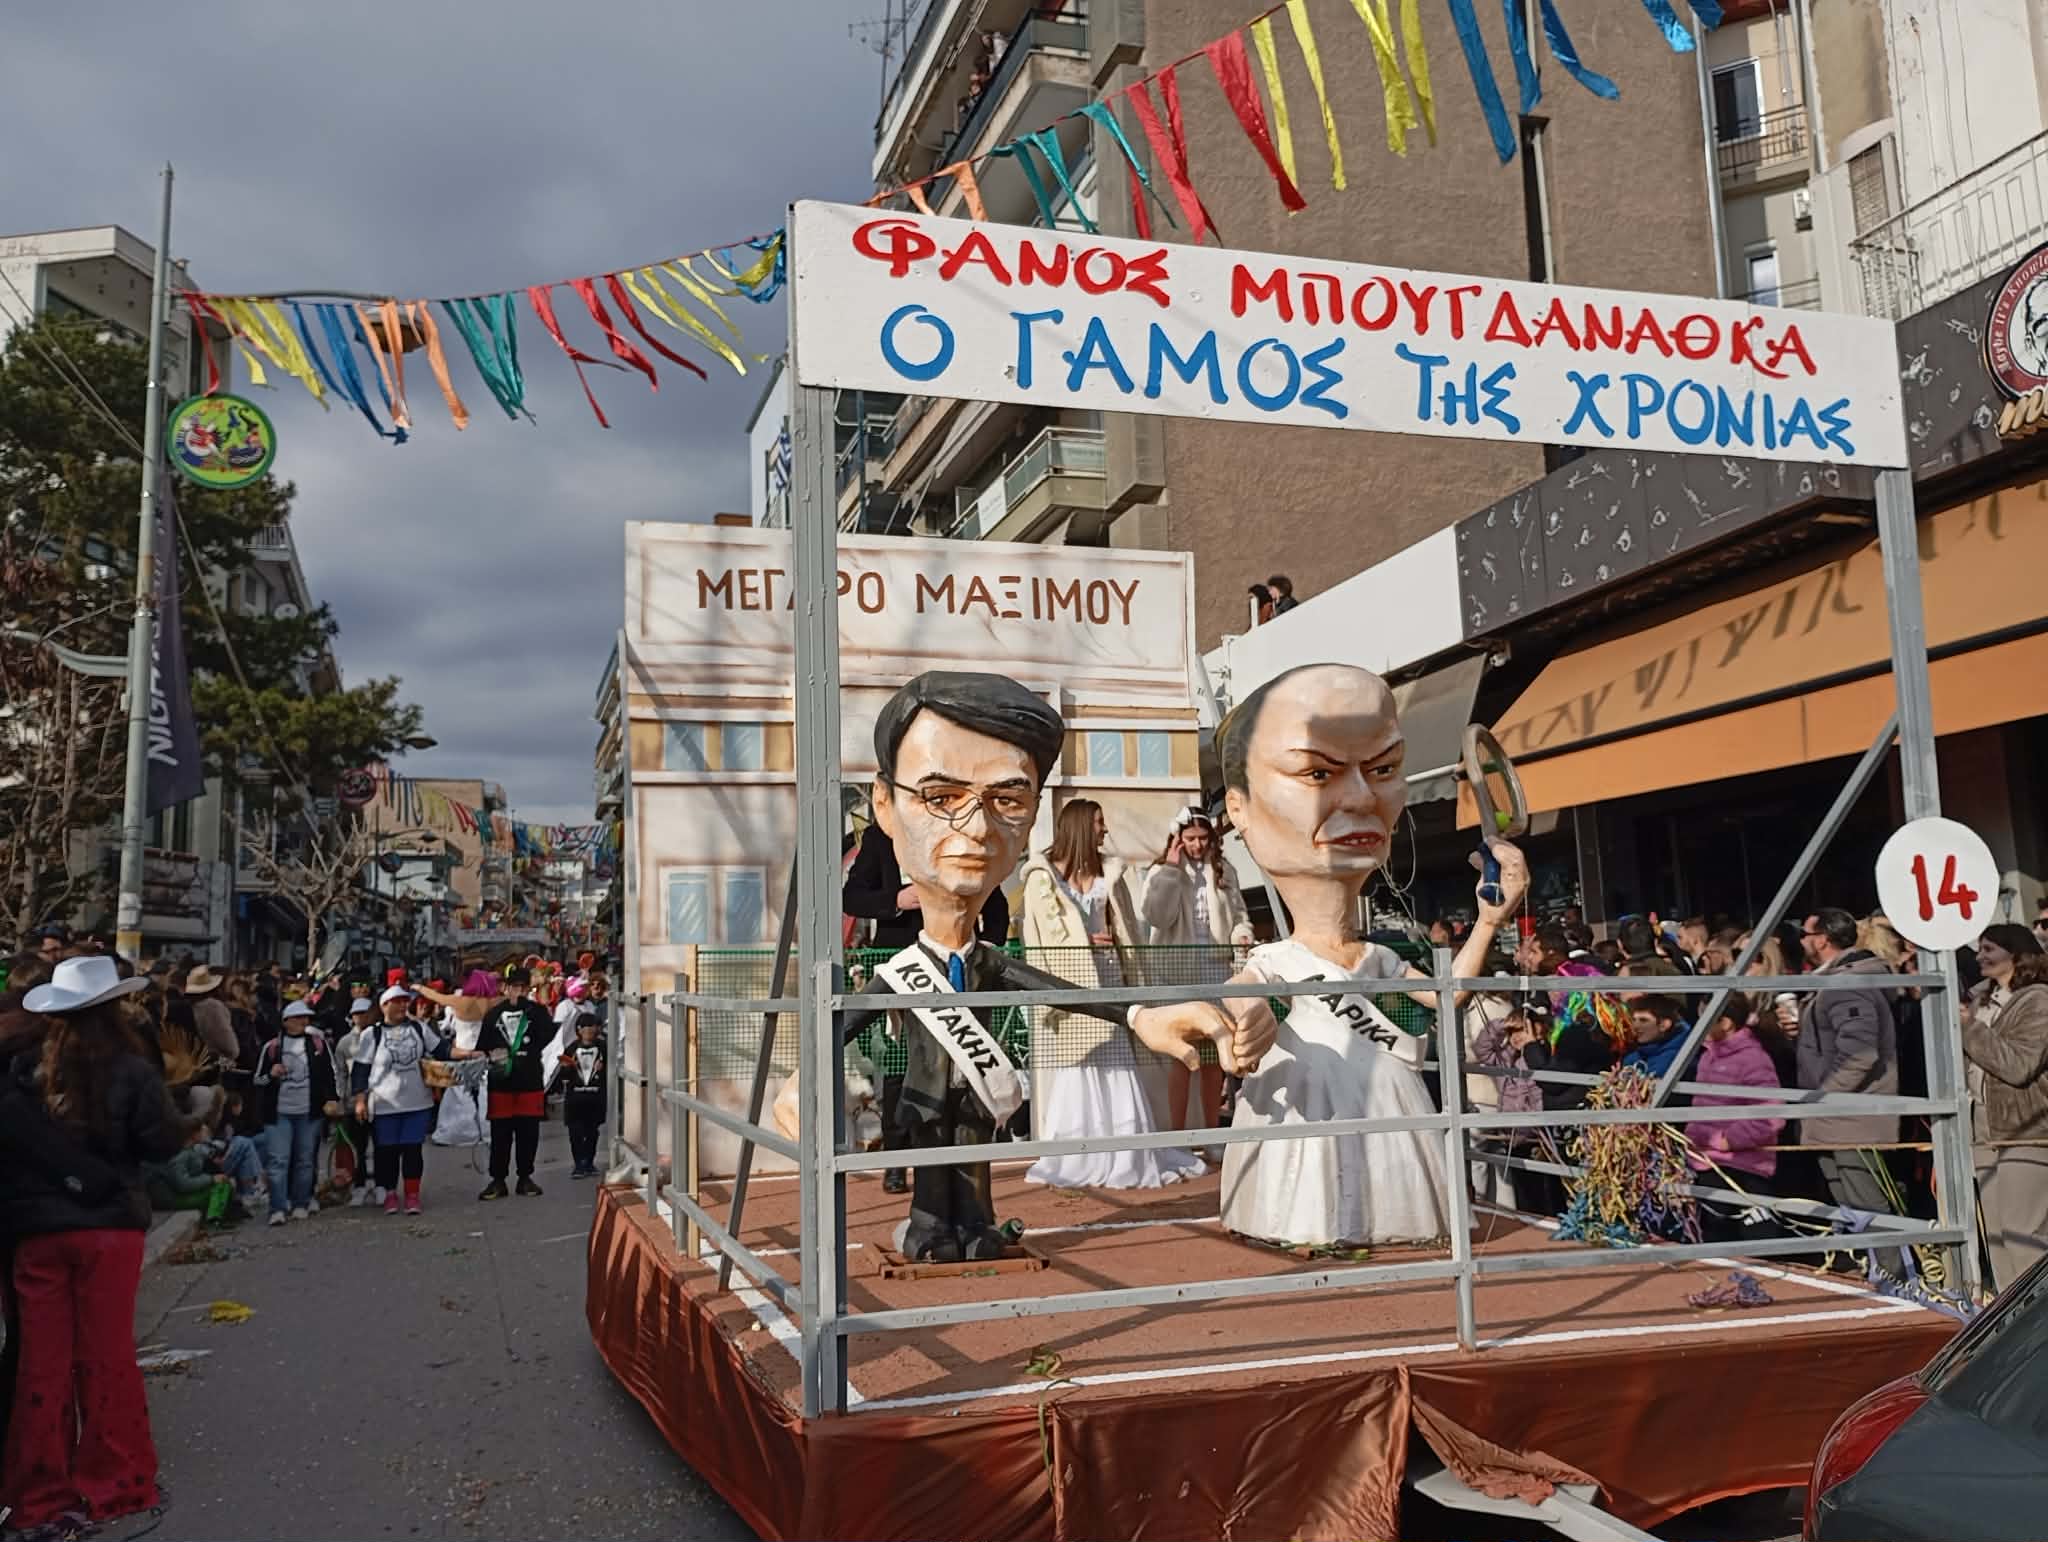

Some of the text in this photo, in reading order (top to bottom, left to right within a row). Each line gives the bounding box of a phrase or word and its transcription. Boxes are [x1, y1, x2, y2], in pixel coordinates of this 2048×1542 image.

[853, 219, 1817, 378] ΦΑΝΟΣ ΜΠΟΥΓΔΑΝΑΘΚΑ
[880, 304, 1855, 456] Ο ΓΑΜΟΣ ΤΗΣ ΧΡΟΝΙΑΣ
[696, 569, 1140, 625] ΜΕΓΡΟ ΜΑΞΙΜΟΥ
[1911, 855, 1978, 921] 14
[1301, 973, 1400, 1052] ΑΡΙΚΑ
